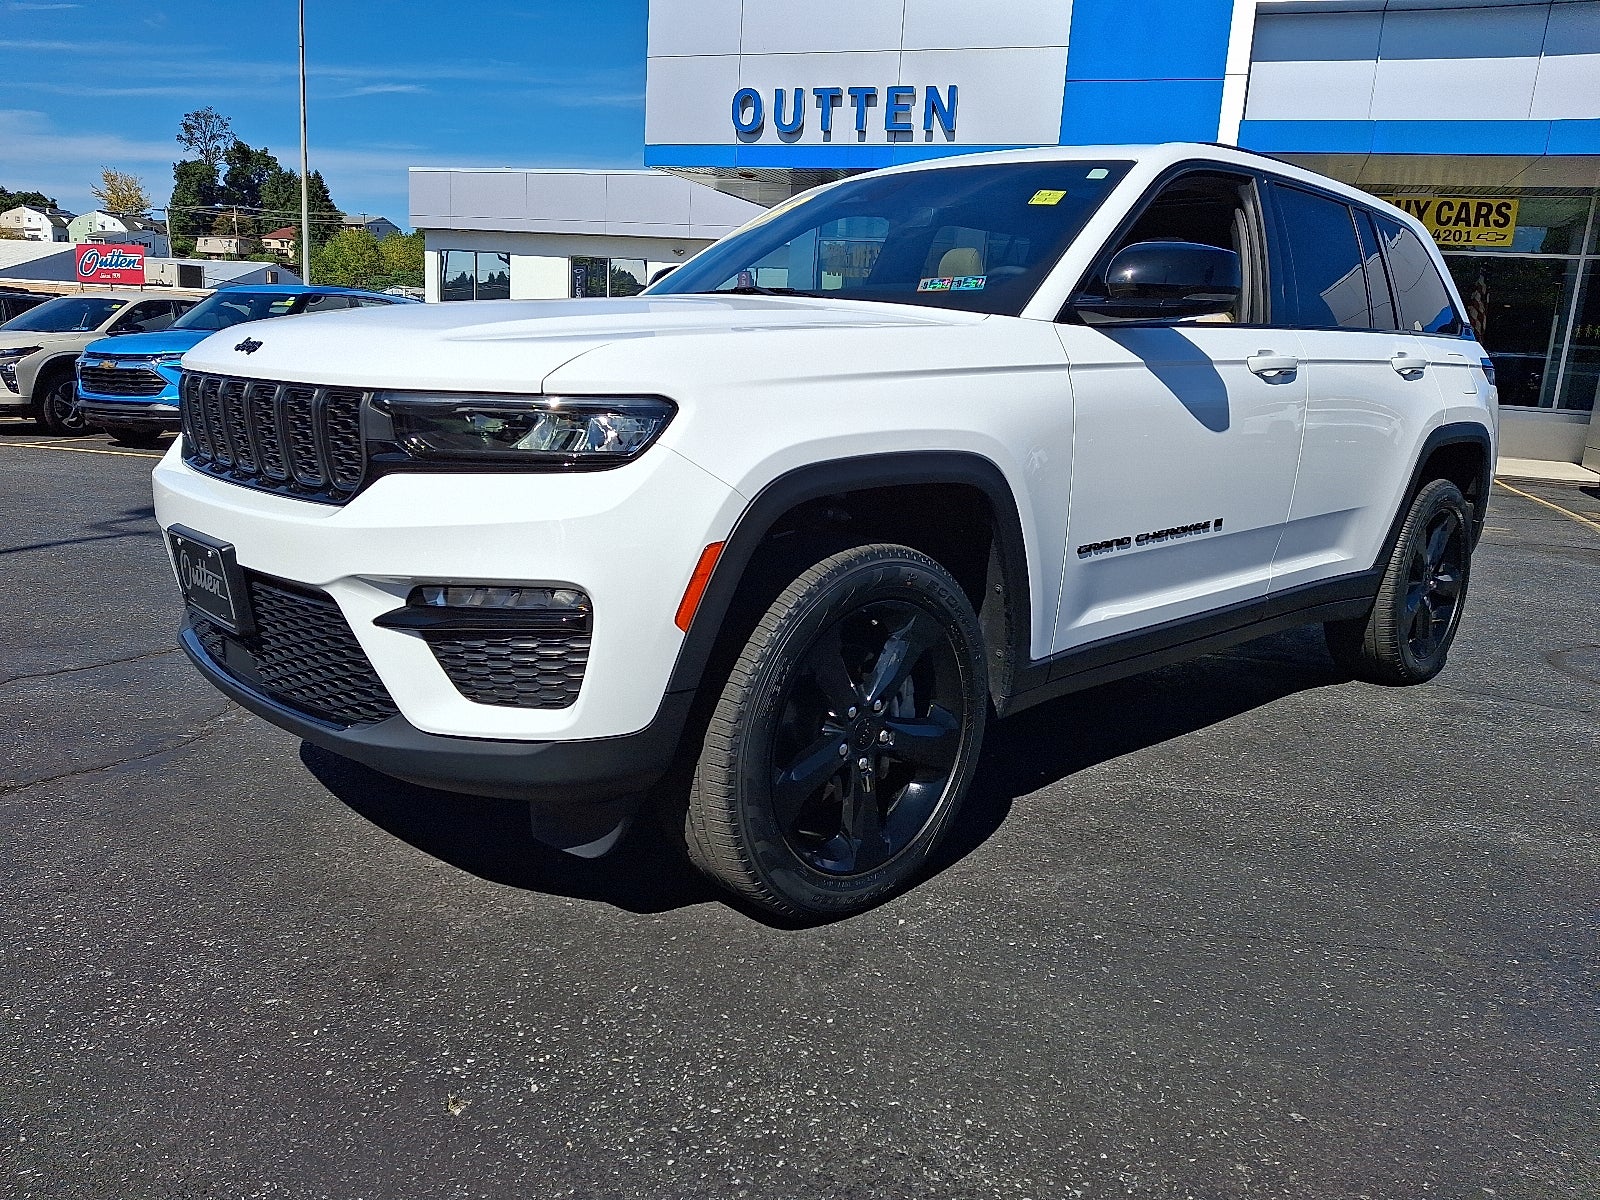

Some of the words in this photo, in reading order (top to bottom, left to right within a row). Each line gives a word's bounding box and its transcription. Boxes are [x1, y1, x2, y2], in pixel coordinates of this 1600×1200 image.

[731, 84, 959, 134] OUTTEN
[1435, 200, 1512, 228] CARS
[1432, 228, 1473, 242] 4201
[79, 248, 143, 276] Outten
[1077, 536, 1132, 555] GRAND
[1135, 520, 1212, 543] CHEROKEE
[179, 549, 228, 601] Outten
